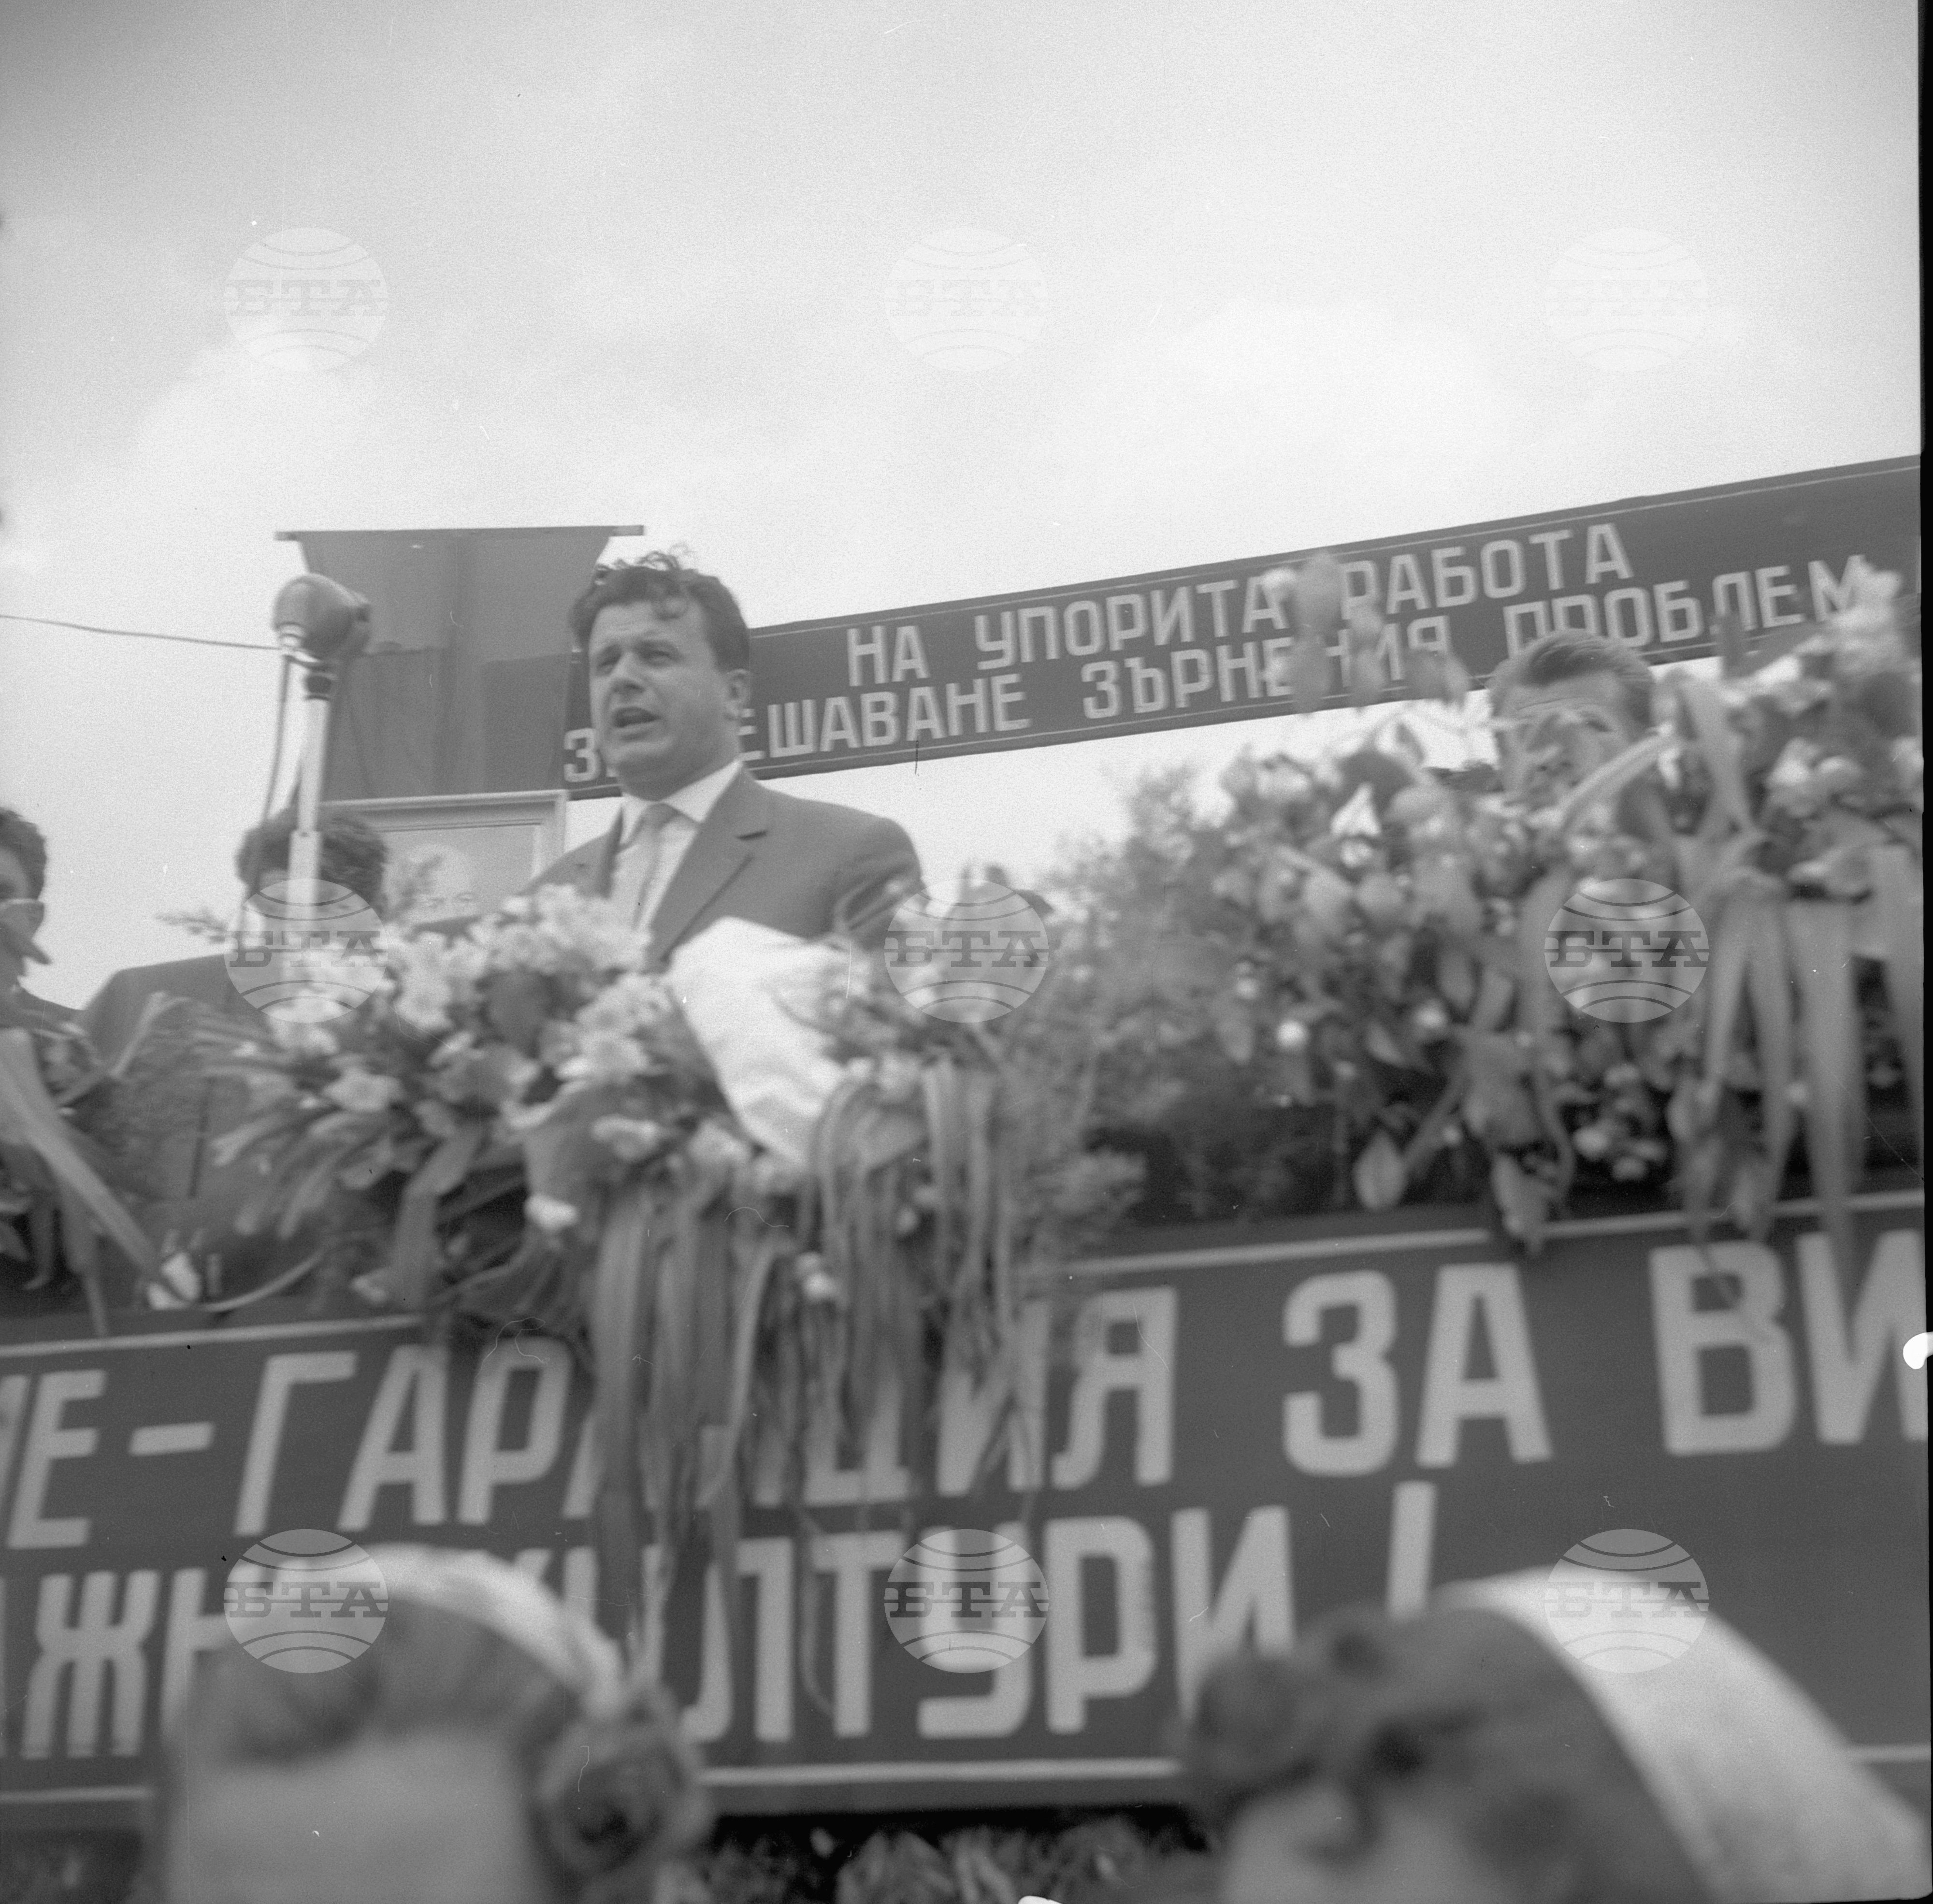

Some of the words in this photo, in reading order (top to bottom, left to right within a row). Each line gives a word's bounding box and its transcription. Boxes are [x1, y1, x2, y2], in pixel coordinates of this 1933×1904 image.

[846, 624, 930, 688] НА
[974, 576, 1292, 671] УПОРИТА
[1340, 522, 1634, 621] РАБОТА
[563, 726, 619, 783] З
[739, 672, 1031, 761] ЕШАВАНЕ
[1283, 1262, 1553, 1477] ЗА
